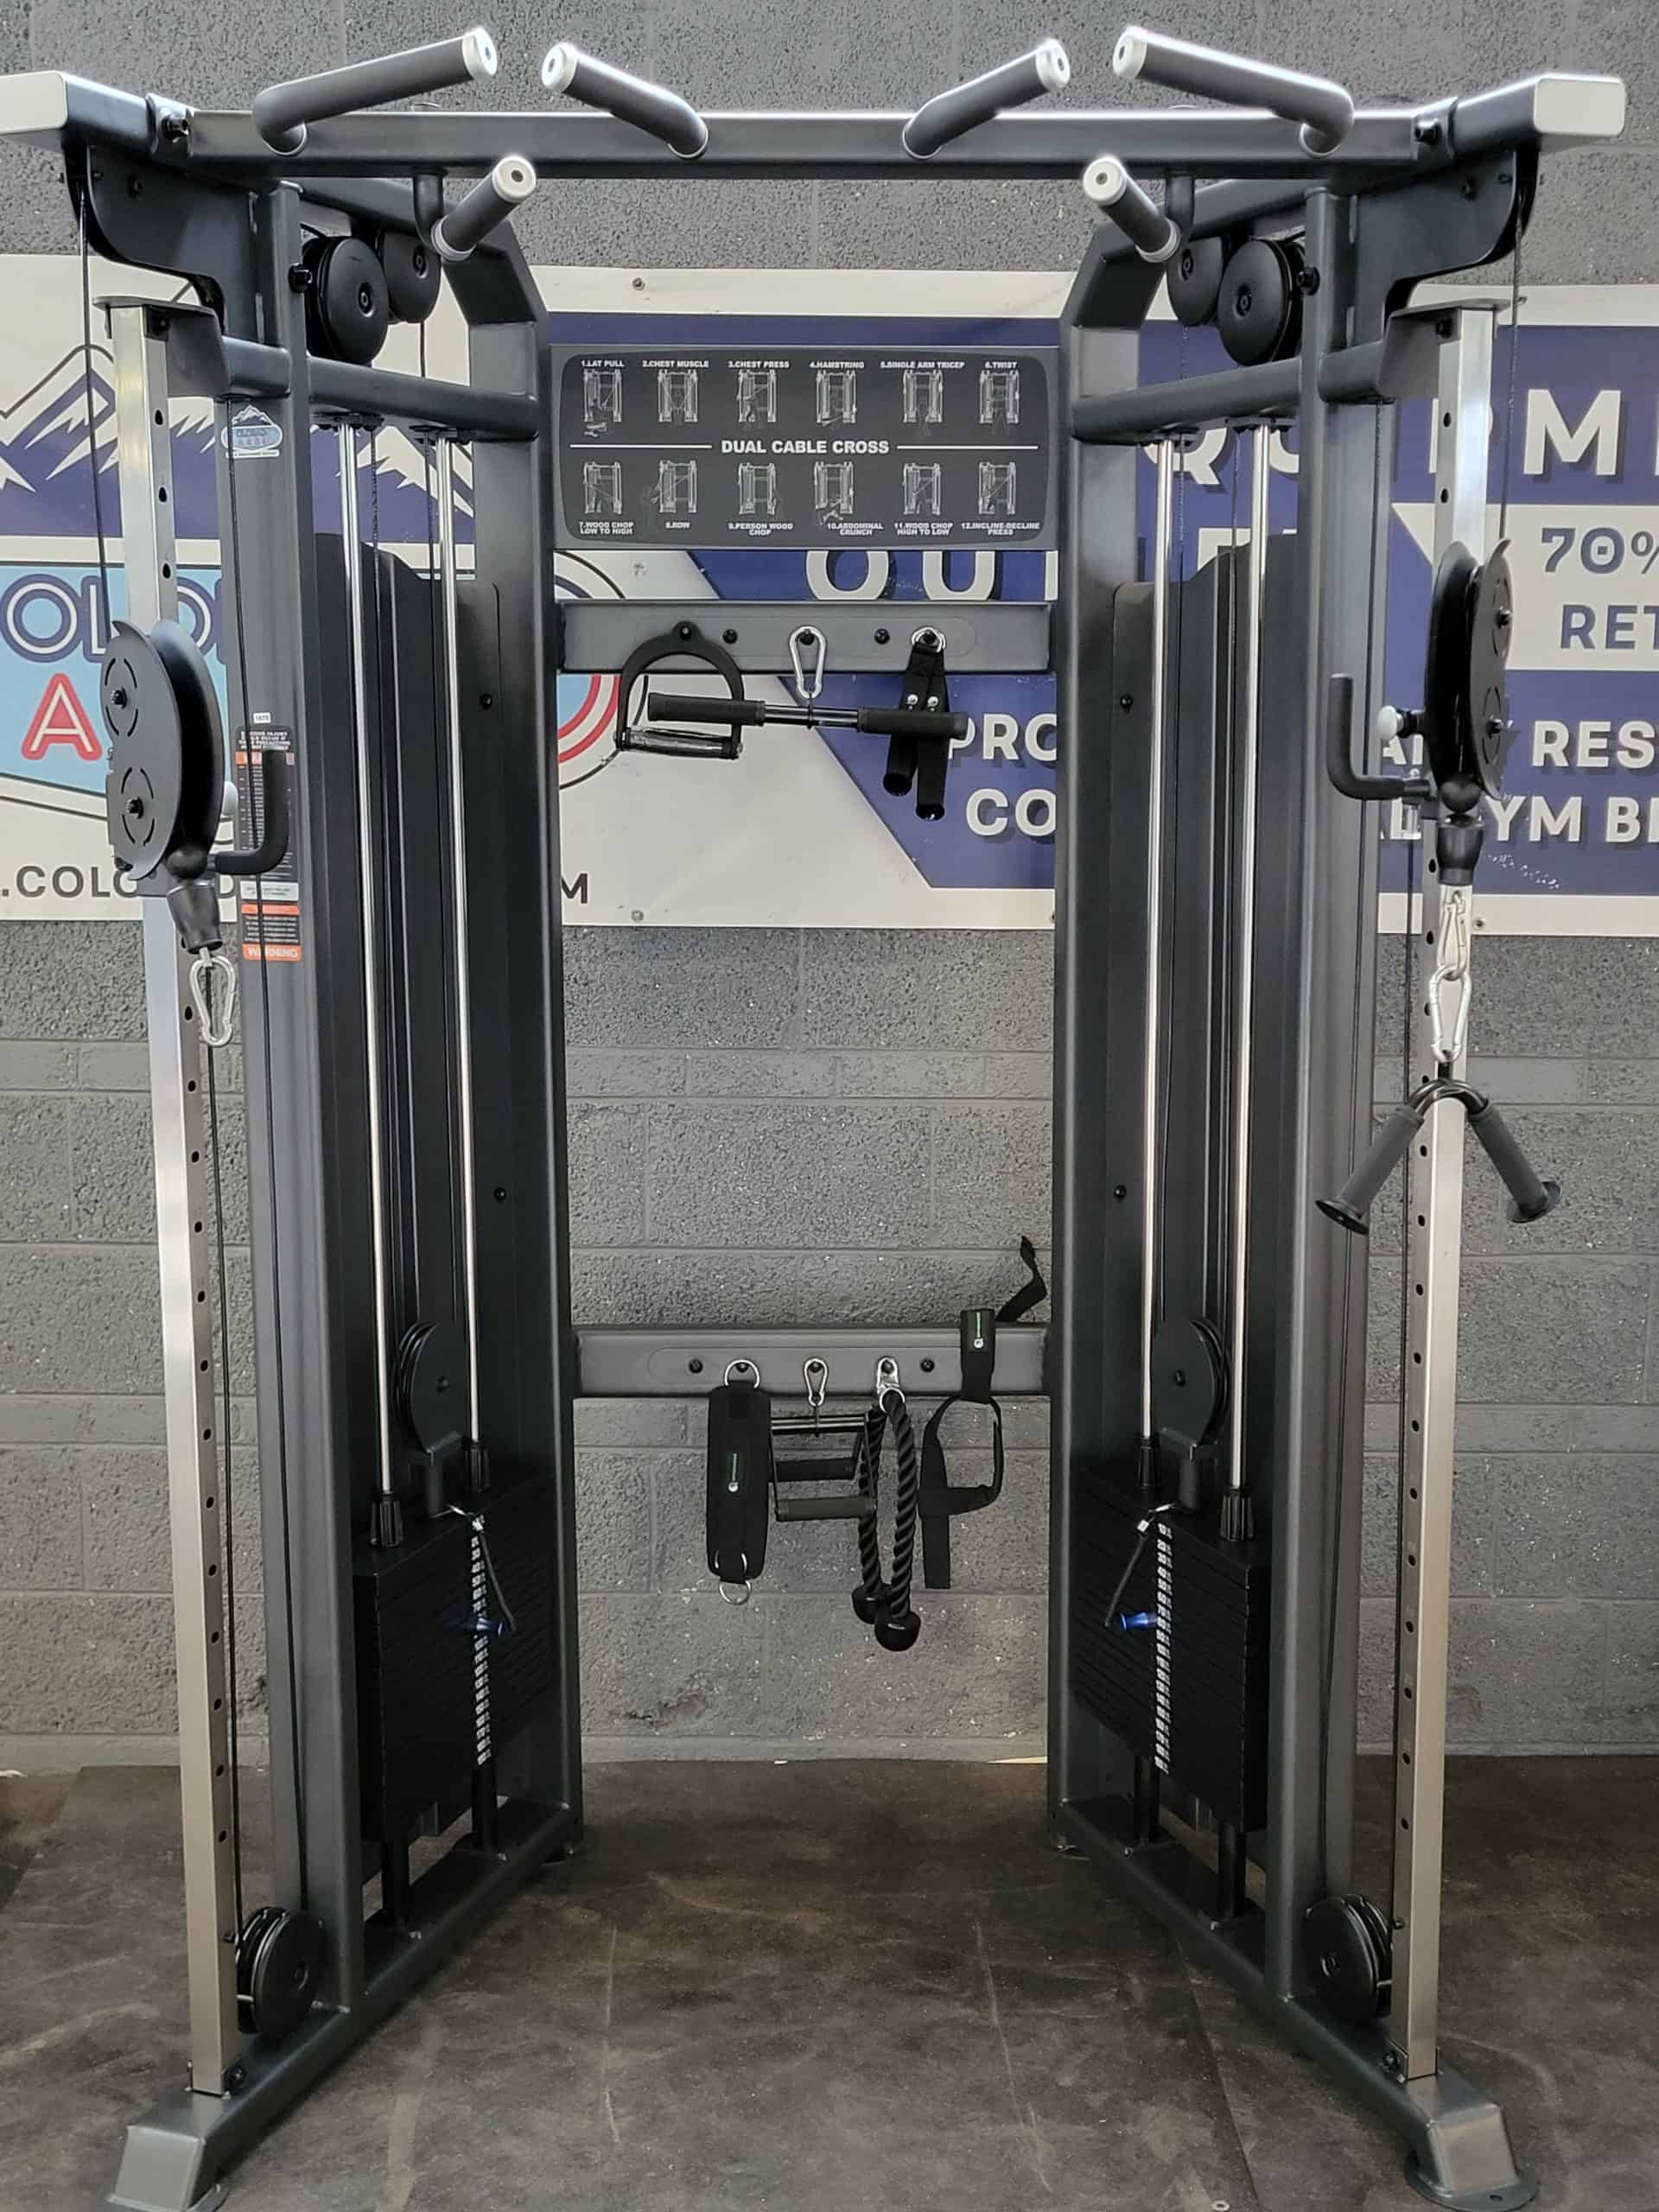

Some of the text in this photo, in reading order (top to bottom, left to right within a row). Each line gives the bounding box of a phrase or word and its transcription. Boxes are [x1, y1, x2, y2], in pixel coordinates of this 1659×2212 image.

[721, 440, 889, 454] DUAL CABLE CROSS
